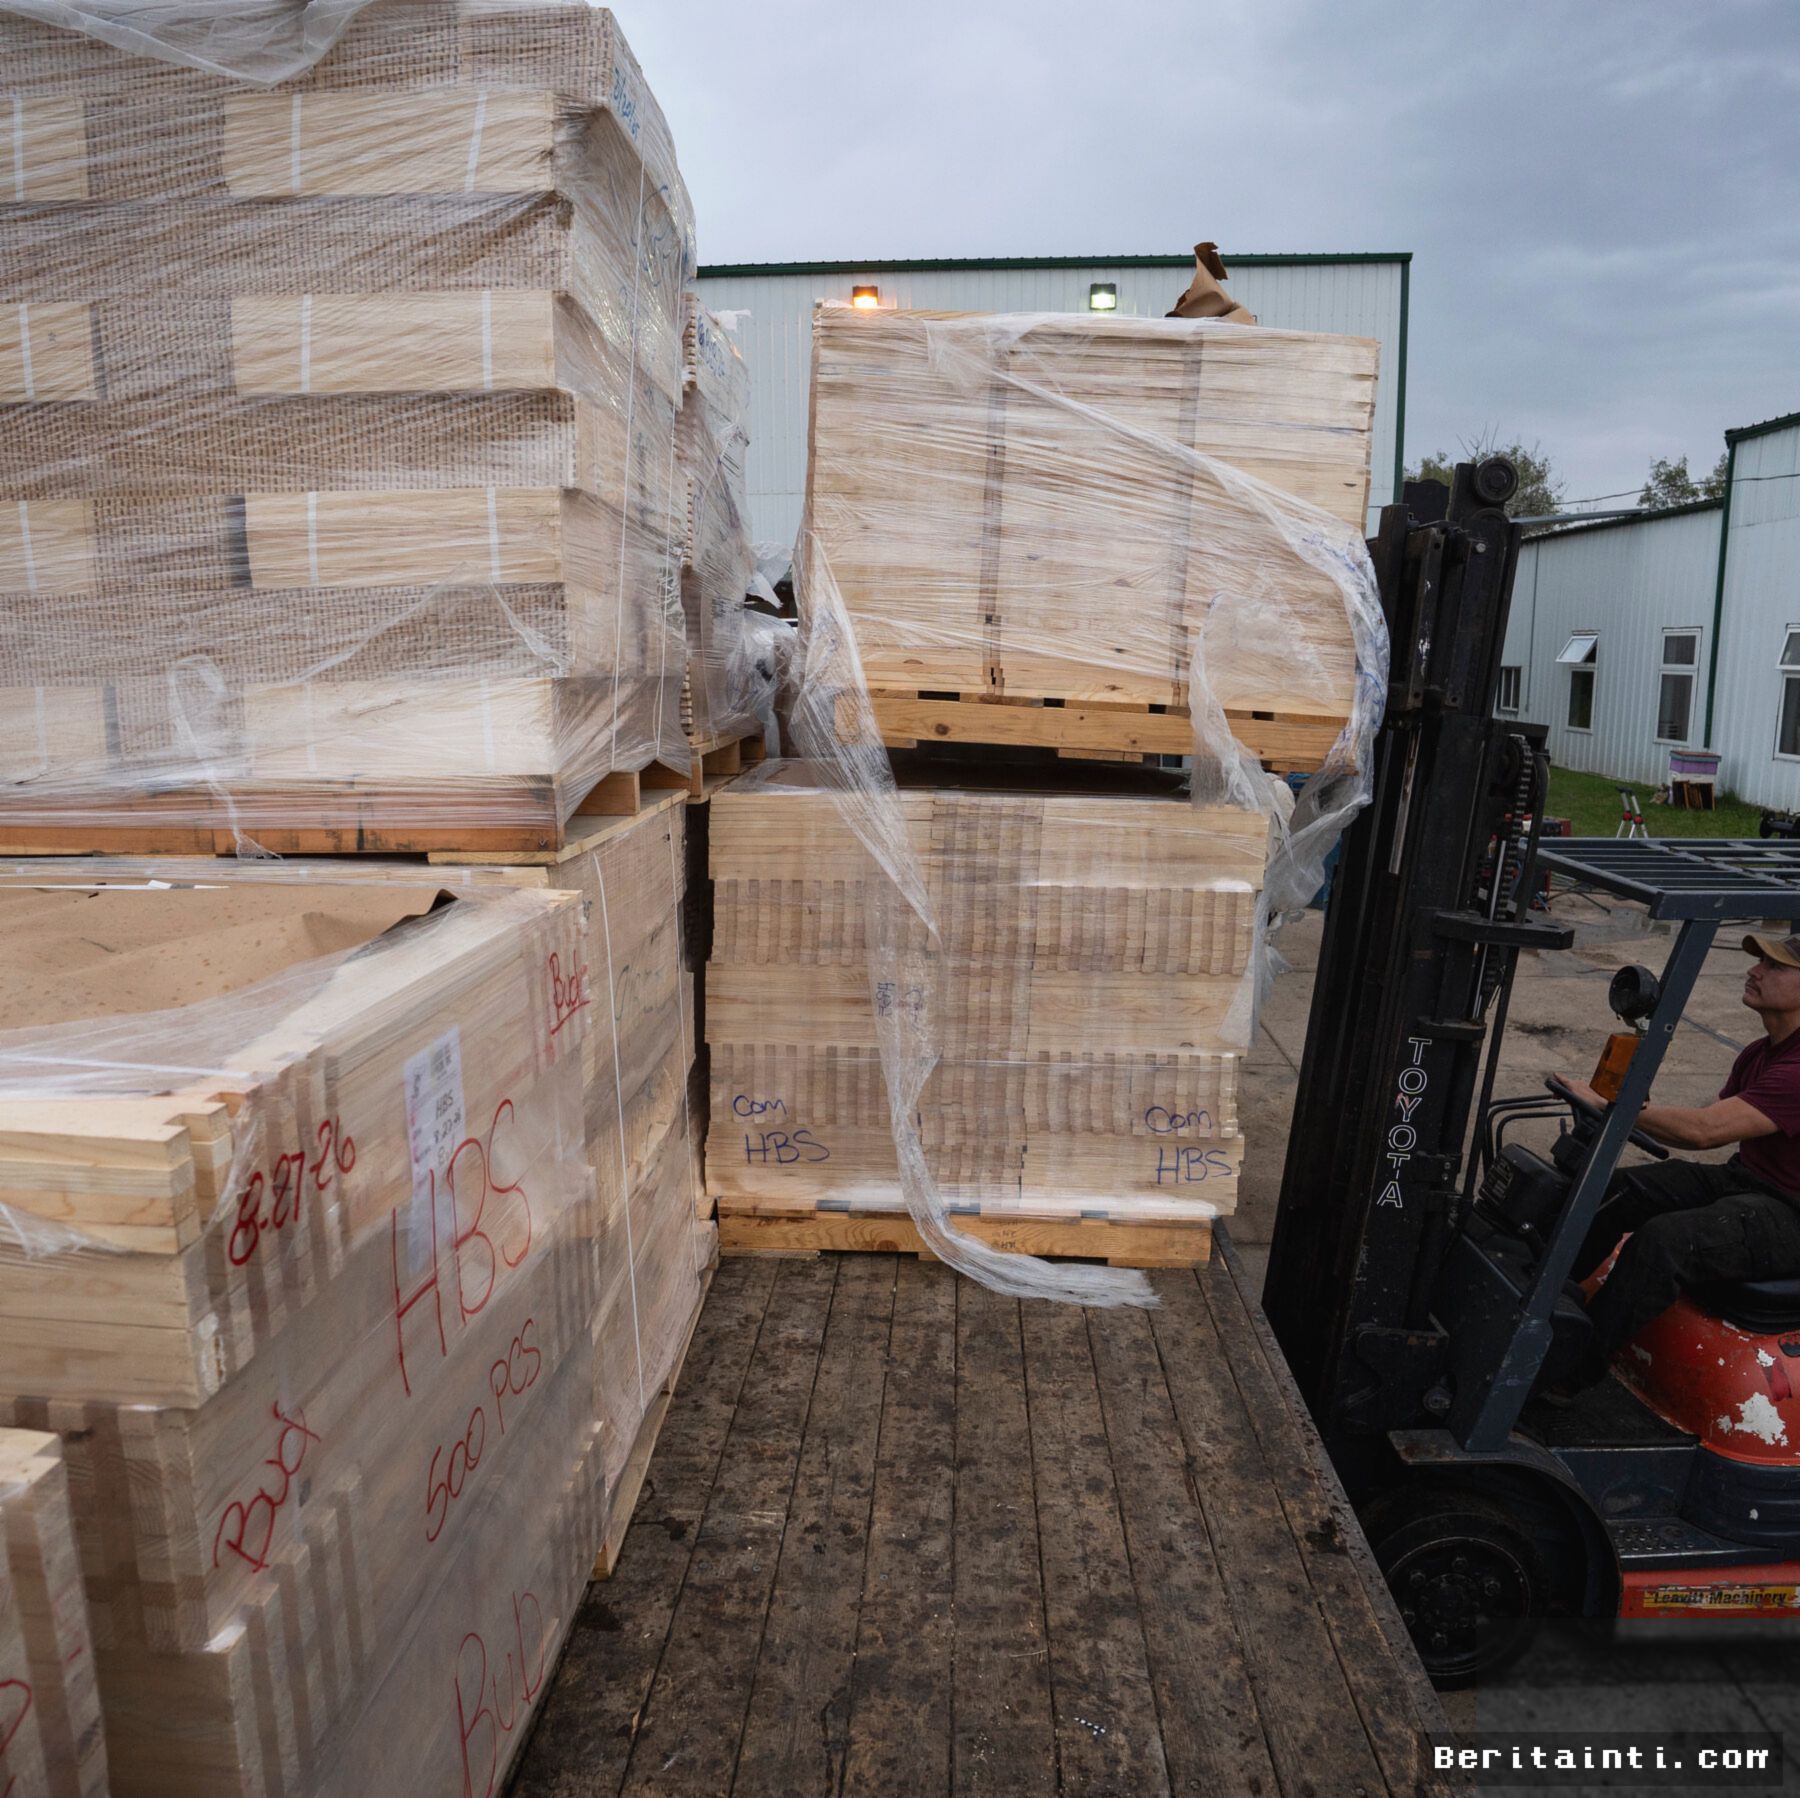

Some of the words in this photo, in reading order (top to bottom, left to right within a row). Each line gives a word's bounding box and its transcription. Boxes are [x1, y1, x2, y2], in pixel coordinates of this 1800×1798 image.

[745, 1130, 830, 1165] HBS
[1155, 1146, 1233, 1186] HBS
[1376, 1036, 1433, 1209] TOYOTA
[392, 1098, 532, 1397] HBS
[426, 1405, 486, 1543] 500
[1708, 1589, 1788, 1605] Machinery
